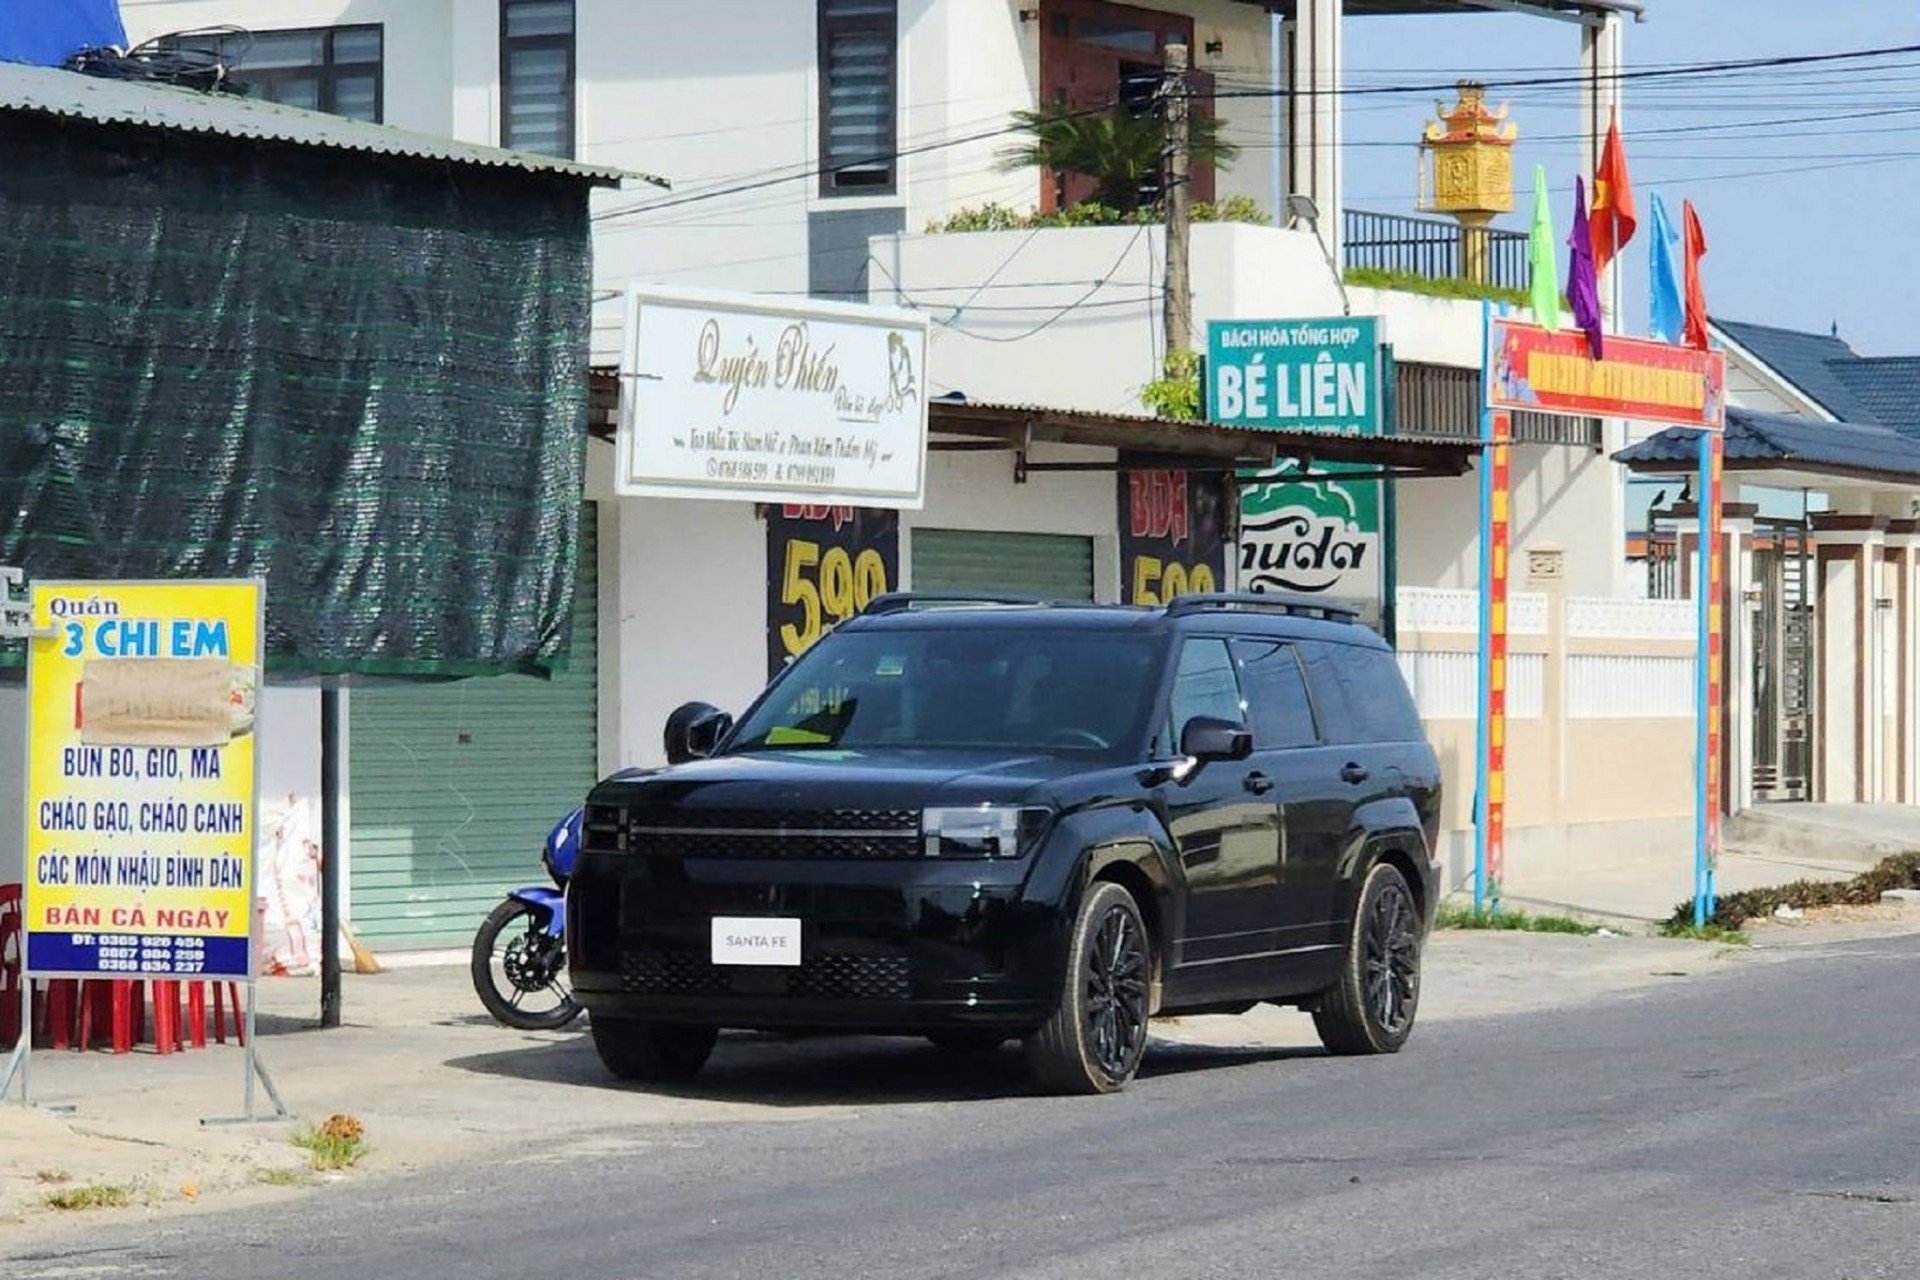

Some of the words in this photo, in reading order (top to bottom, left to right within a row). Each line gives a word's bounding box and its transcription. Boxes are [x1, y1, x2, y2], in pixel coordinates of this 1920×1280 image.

[1221, 328, 1257, 348] BÁCH
[1259, 326, 1289, 346] HÓA
[1290, 323, 1329, 346] TỔNG
[1330, 327, 1360, 349] HỢP
[1217, 352, 1268, 419] BÉ
[1276, 350, 1366, 418] LIÊN
[50, 596, 119, 616] Quán
[64, 621, 83, 656] 3
[172, 621, 228, 656] EM
[40, 796, 87, 831] CHÁO
[94, 801, 133, 839] GẠO,
[139, 796, 188, 833] CHÁO
[193, 803, 243, 833] CANH
[37, 849, 69, 884] CÁC
[75, 849, 112, 885] MÓN
[117, 849, 161, 894] NHẬU
[165, 850, 204, 887] BÌNH
[209, 851, 243, 888] DÂN
[46, 903, 100, 925] BÁN
[156, 906, 229, 929] NGÀY
[726, 935, 769, 948] SANTA
[771, 936, 788, 948] FE
